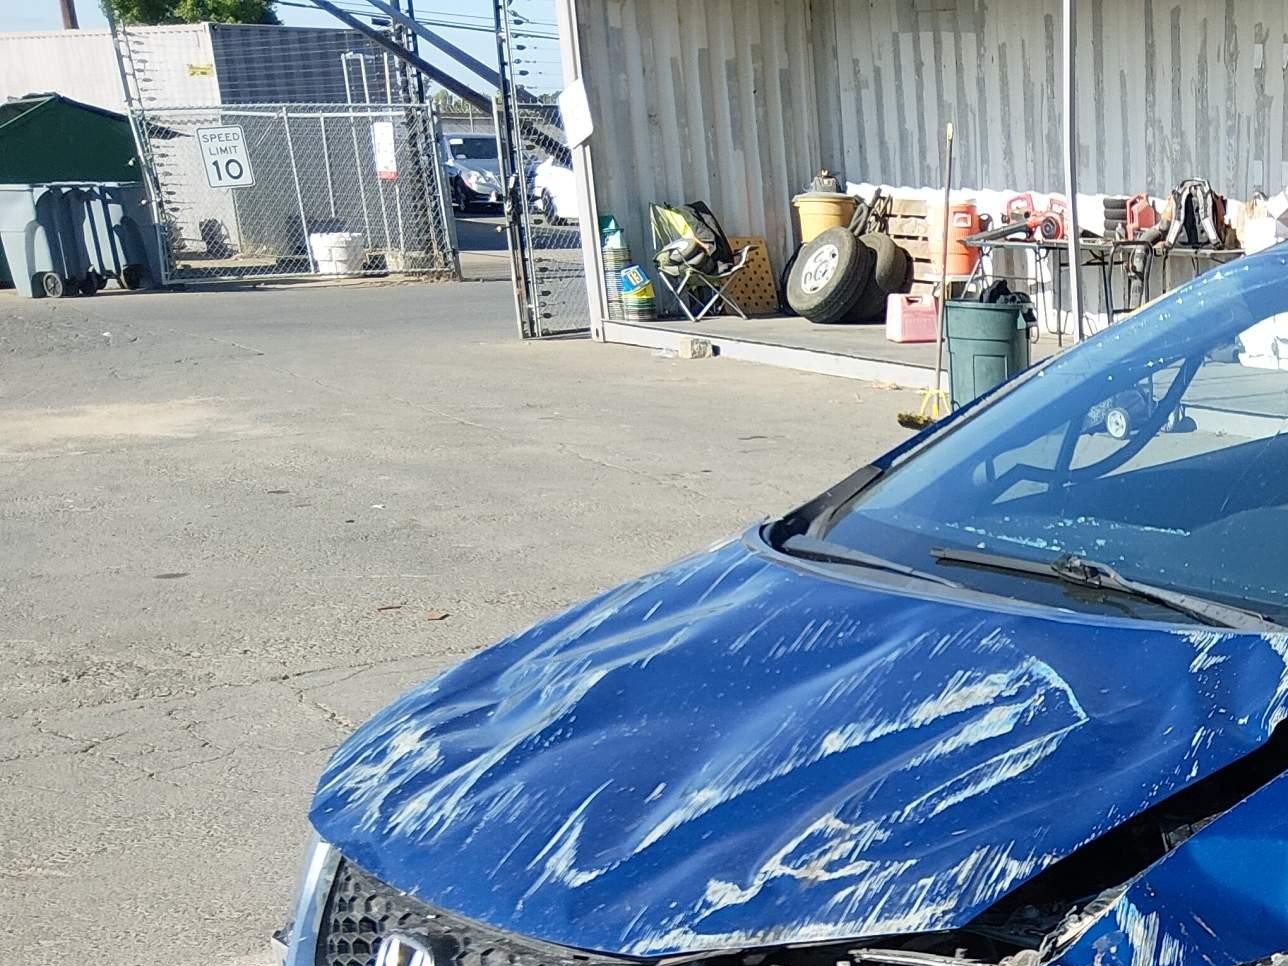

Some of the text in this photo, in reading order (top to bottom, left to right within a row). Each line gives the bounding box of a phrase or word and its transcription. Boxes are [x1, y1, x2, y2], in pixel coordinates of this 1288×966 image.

[202, 132, 240, 143] SPEED
[208, 145, 239, 156] LIMIT
[212, 158, 244, 181] 10
